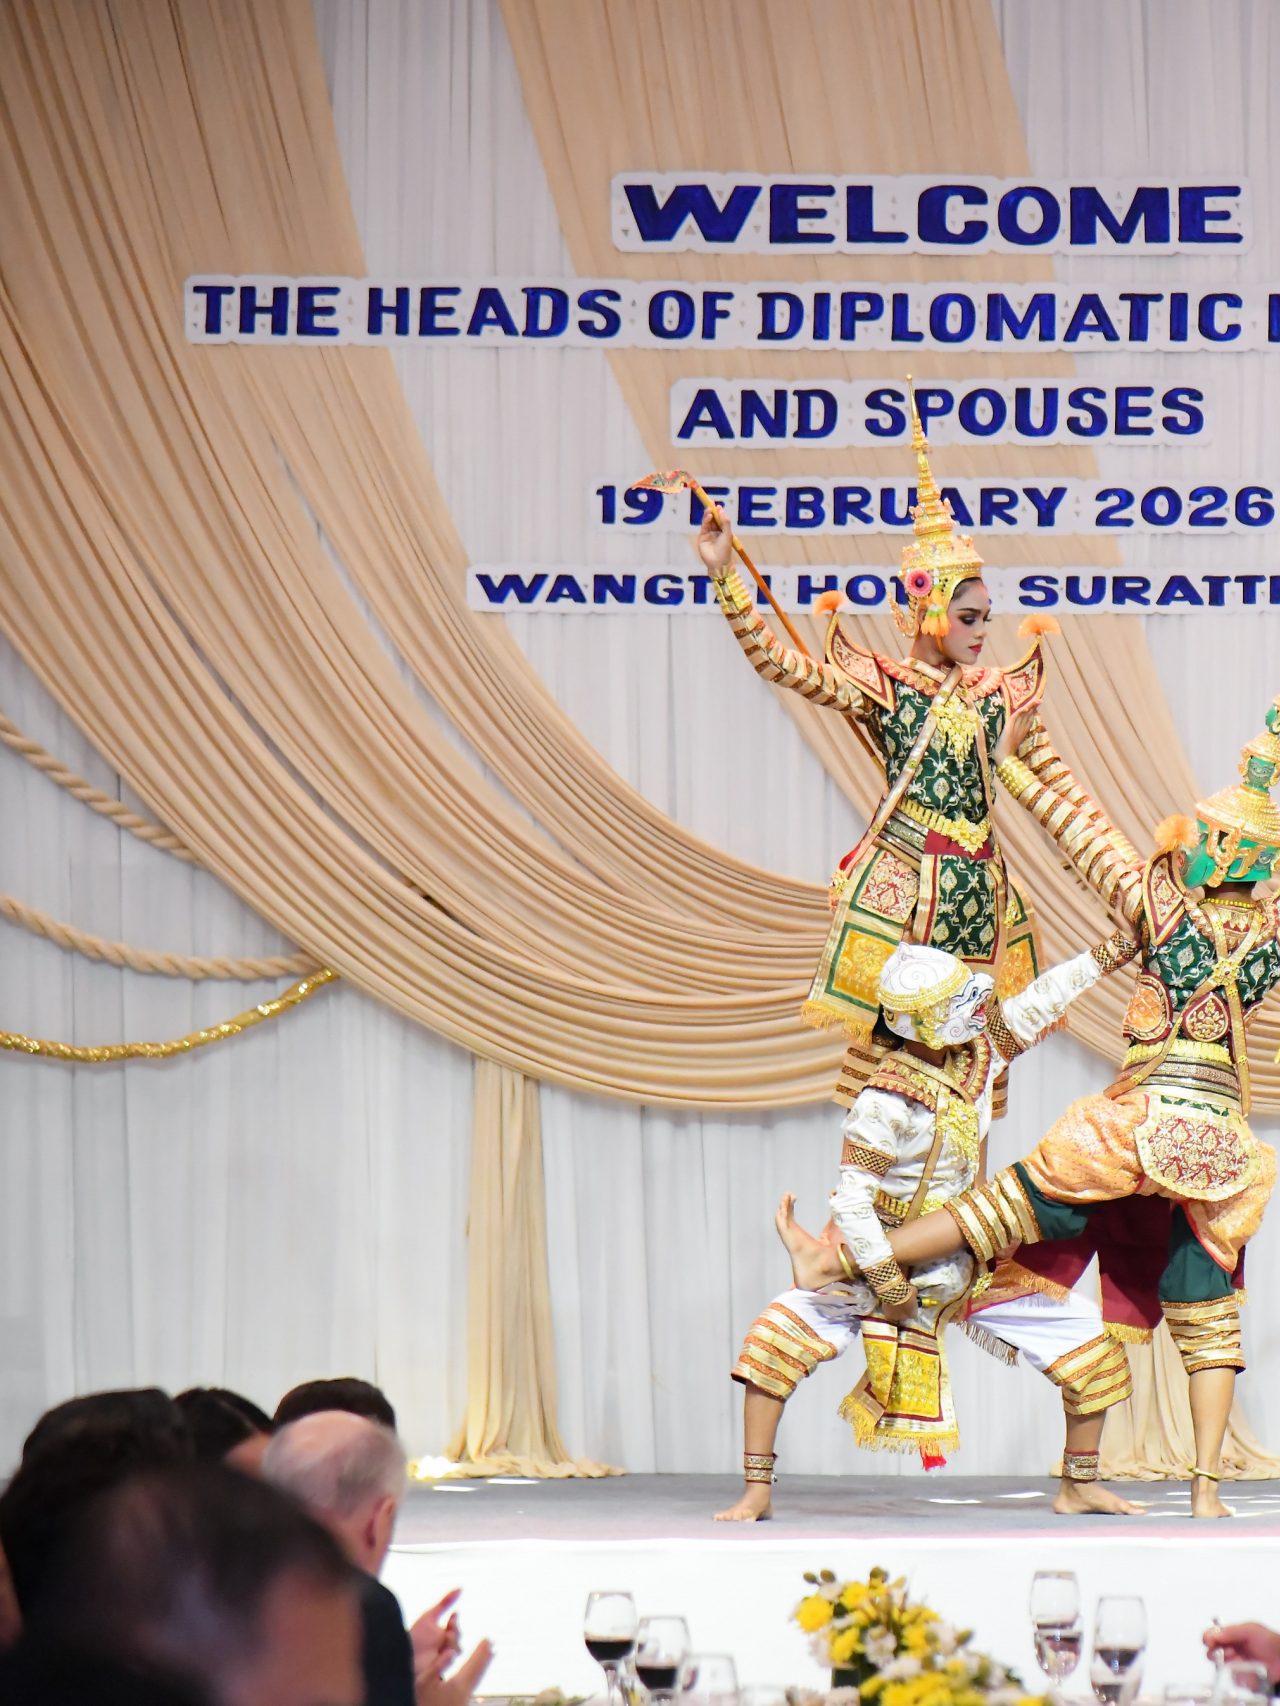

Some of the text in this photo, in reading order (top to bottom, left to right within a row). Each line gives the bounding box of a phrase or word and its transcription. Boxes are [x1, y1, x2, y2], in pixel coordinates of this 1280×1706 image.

[617, 185, 1243, 246] WELCOME
[192, 287, 343, 337] THE
[366, 287, 621, 339] HEADS
[648, 291, 735, 340] OF
[759, 292, 1243, 343] DIPLOMATIC
[676, 386, 1203, 440] AND SPOUSES
[596, 484, 665, 525] 19
[1095, 486, 1275, 528] 2026
[475, 573, 773, 606] WANGTI
[796, 574, 993, 606] HOT
